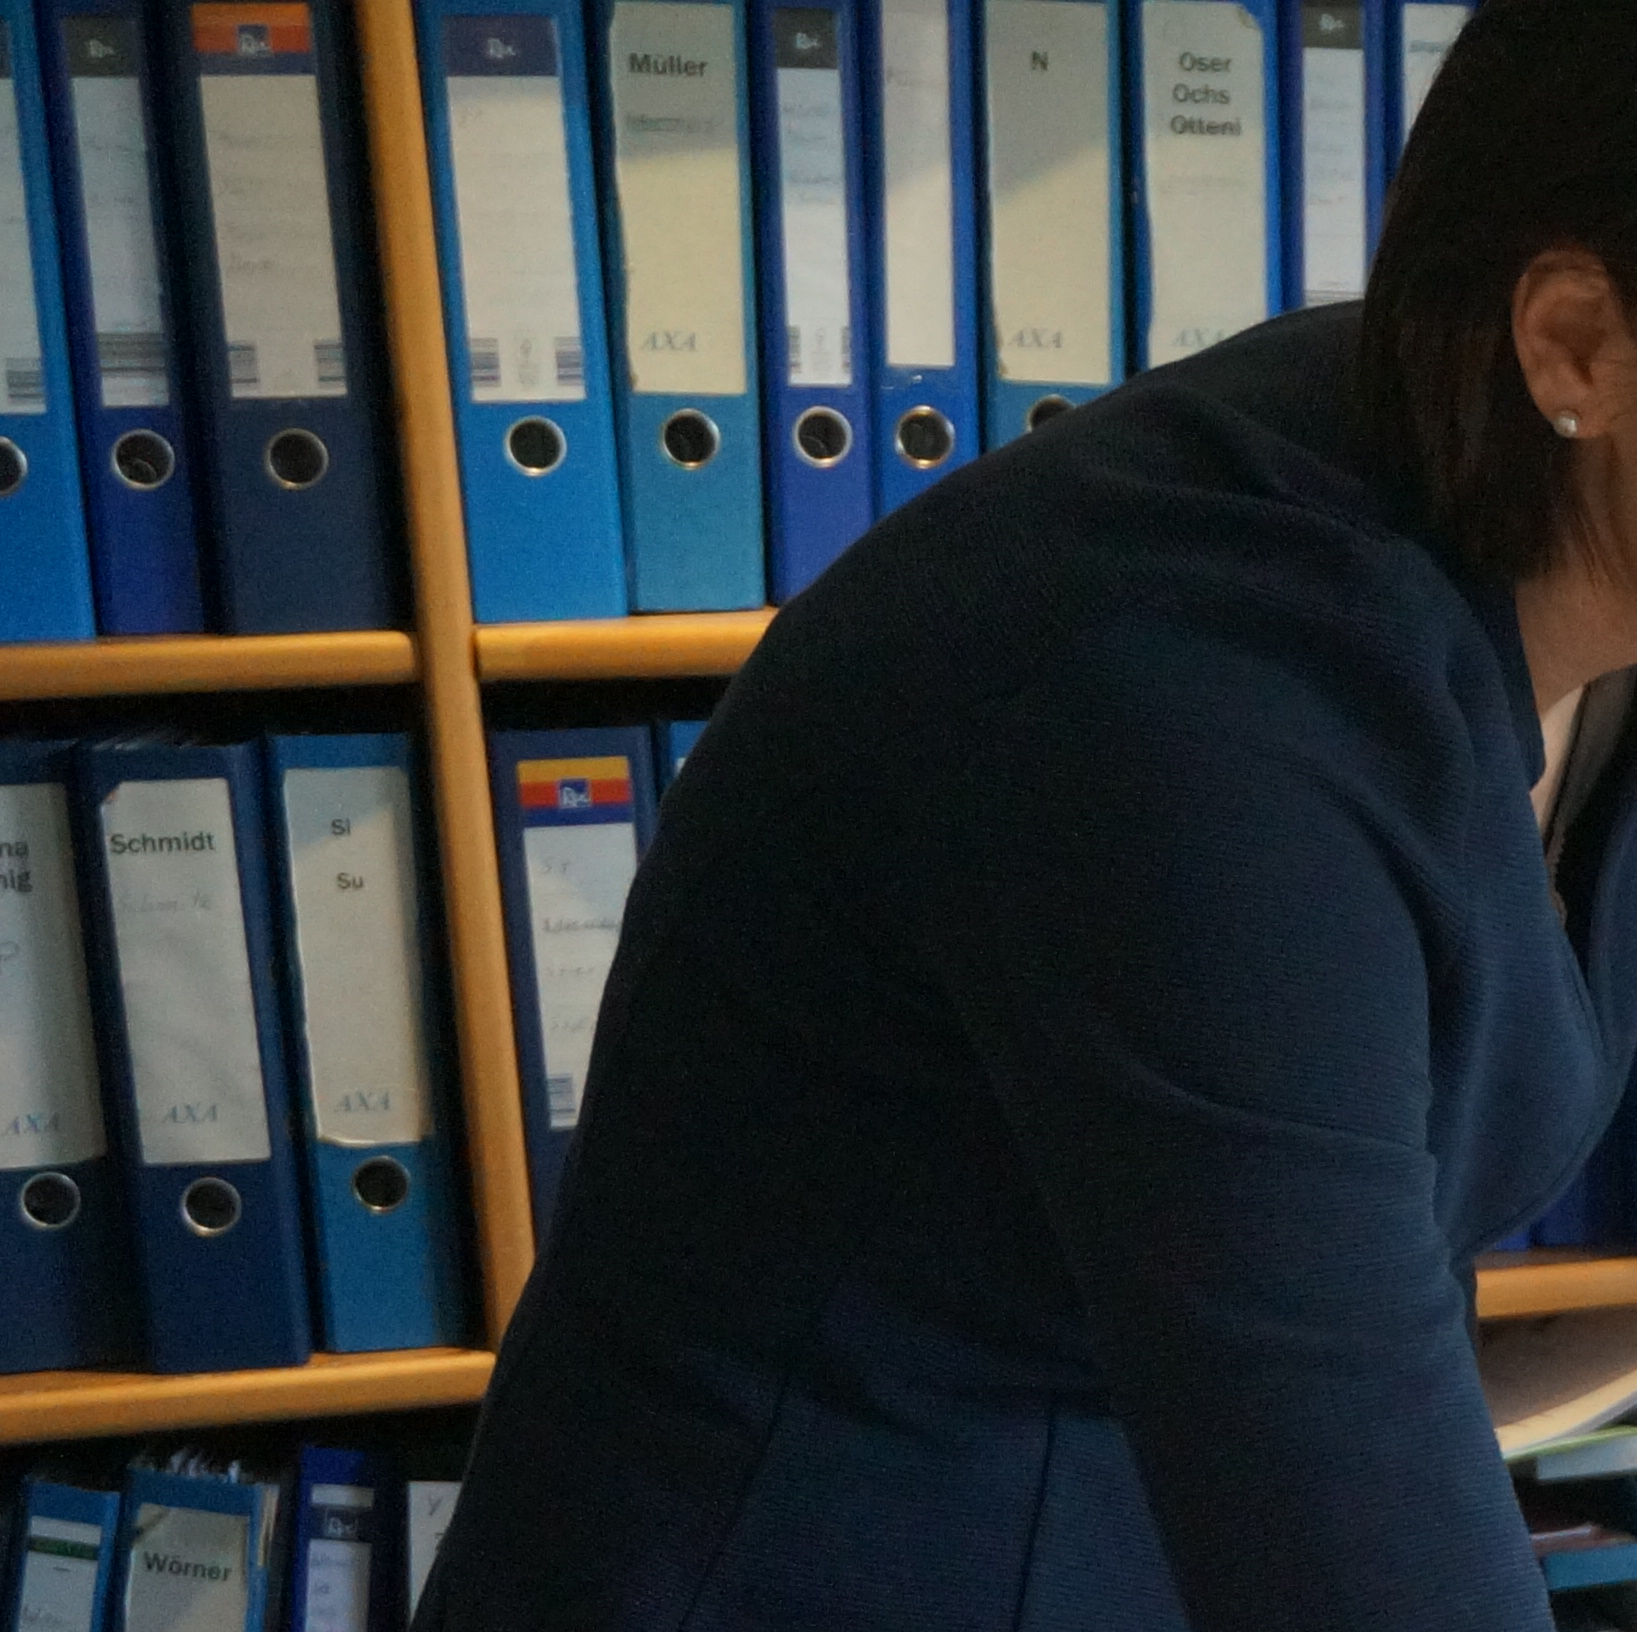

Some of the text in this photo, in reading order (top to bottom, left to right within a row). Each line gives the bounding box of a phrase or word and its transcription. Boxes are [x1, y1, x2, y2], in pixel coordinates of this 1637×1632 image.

[628, 52, 708, 77] Müller
[1031, 51, 1049, 71] N
[1179, 52, 1232, 72] Oser
[1173, 83, 1231, 104] Ochs
[110, 831, 215, 855] Schmidt
[336, 871, 364, 892] Su
[333, 1091, 392, 1114] AXA
[163, 1103, 220, 1125] AXA
[141, 1550, 233, 1583] Wörner
